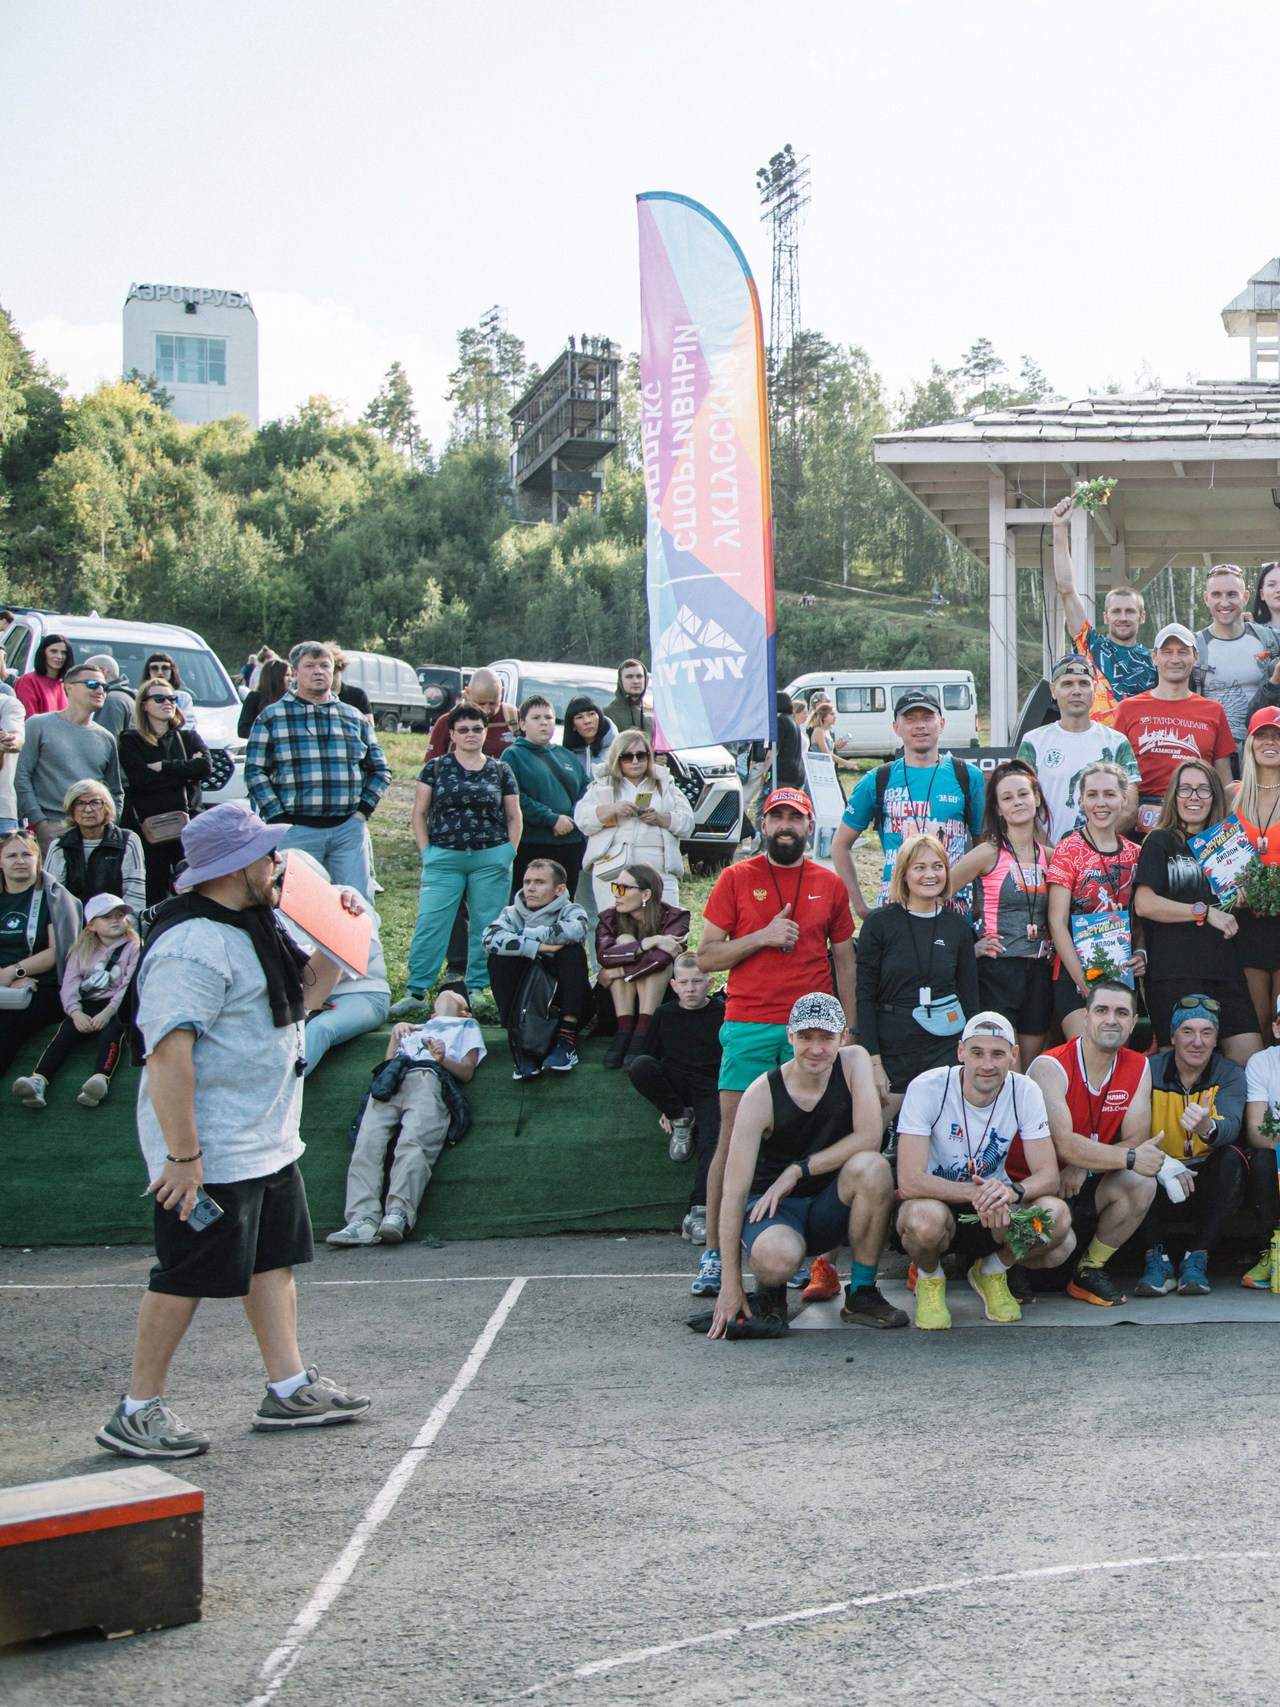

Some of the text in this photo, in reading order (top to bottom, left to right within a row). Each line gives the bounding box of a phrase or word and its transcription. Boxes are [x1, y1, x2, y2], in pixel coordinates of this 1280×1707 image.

[127, 282, 253, 309] АЭРОТРУБА
[1153, 717, 1209, 731] ТАТФОНДБАНК
[1216, 846, 1239, 864] ДИПЛОМ
[1091, 940, 1116, 949] ДИПЛОМ
